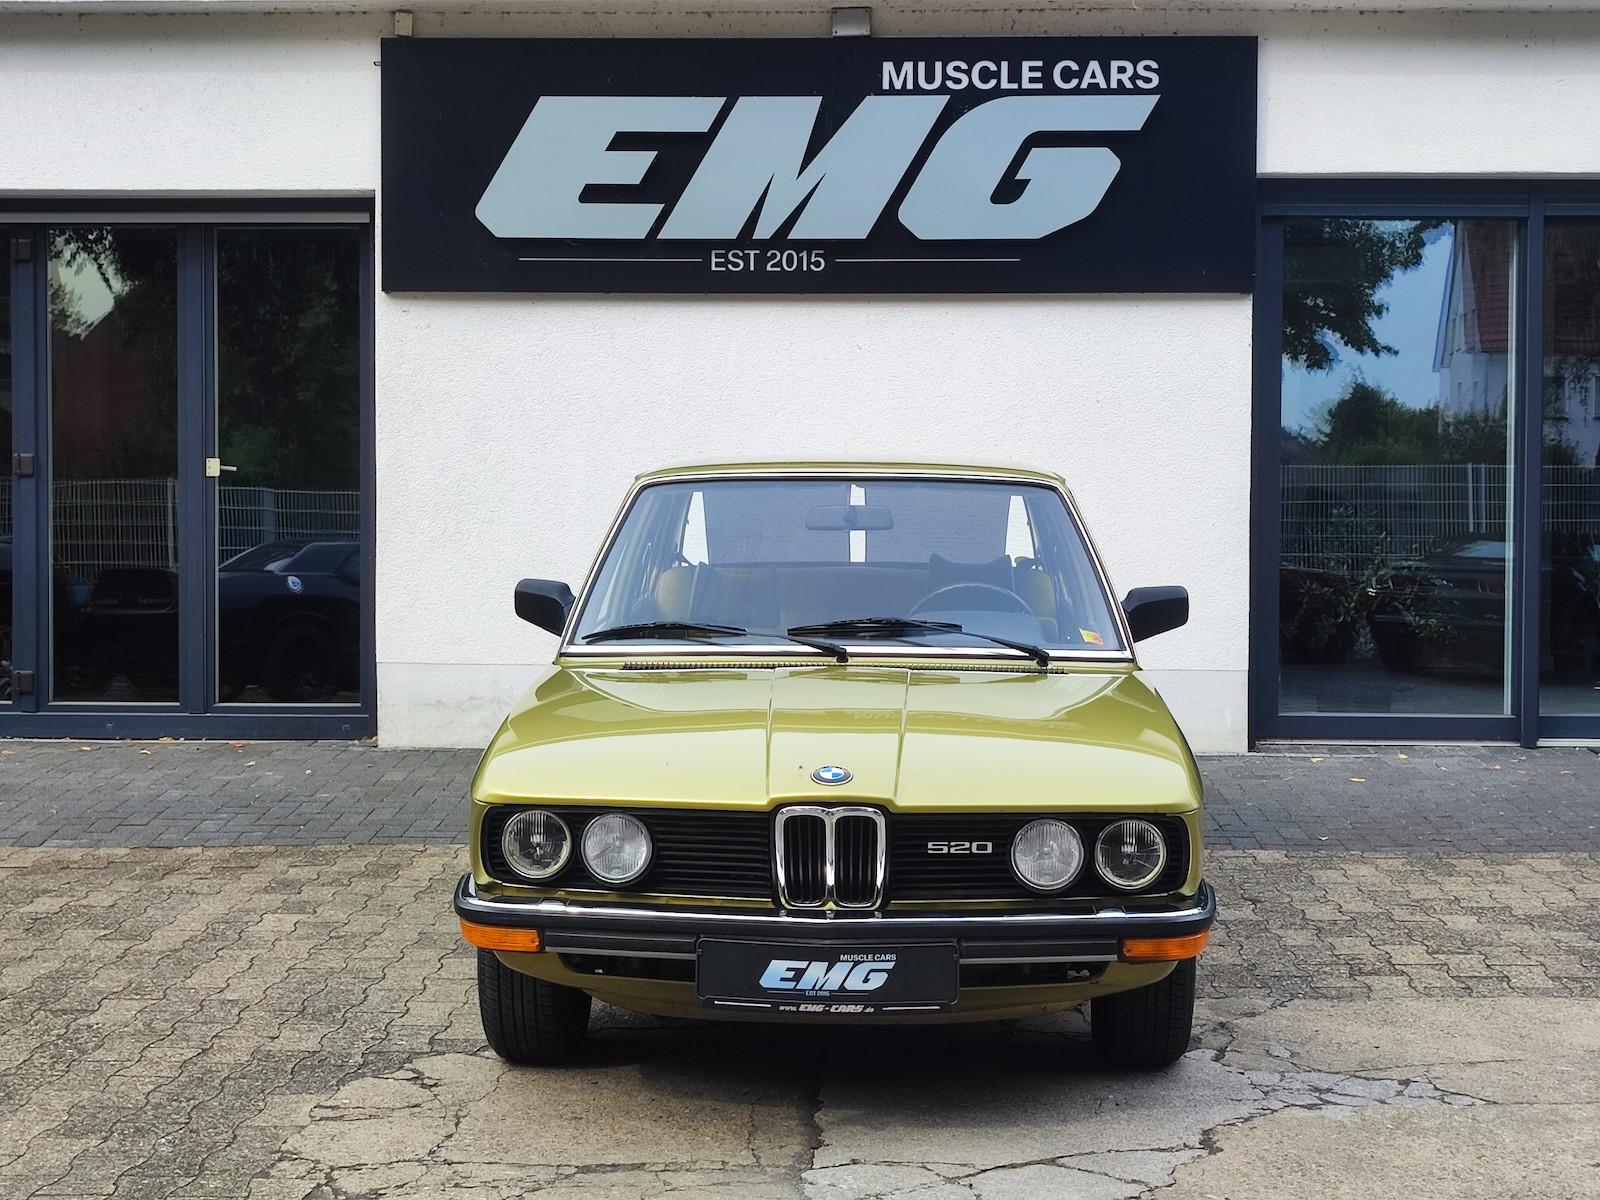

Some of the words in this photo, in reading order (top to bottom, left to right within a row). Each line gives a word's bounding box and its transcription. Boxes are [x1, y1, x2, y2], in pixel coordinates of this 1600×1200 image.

[881, 61, 1043, 91] MUSCLE
[1052, 59, 1160, 91] CARS
[475, 95, 1160, 240] EMG
[710, 250, 759, 273] EST
[765, 250, 826, 273] 2015
[927, 842, 992, 854] 520
[758, 959, 896, 991] EMG
